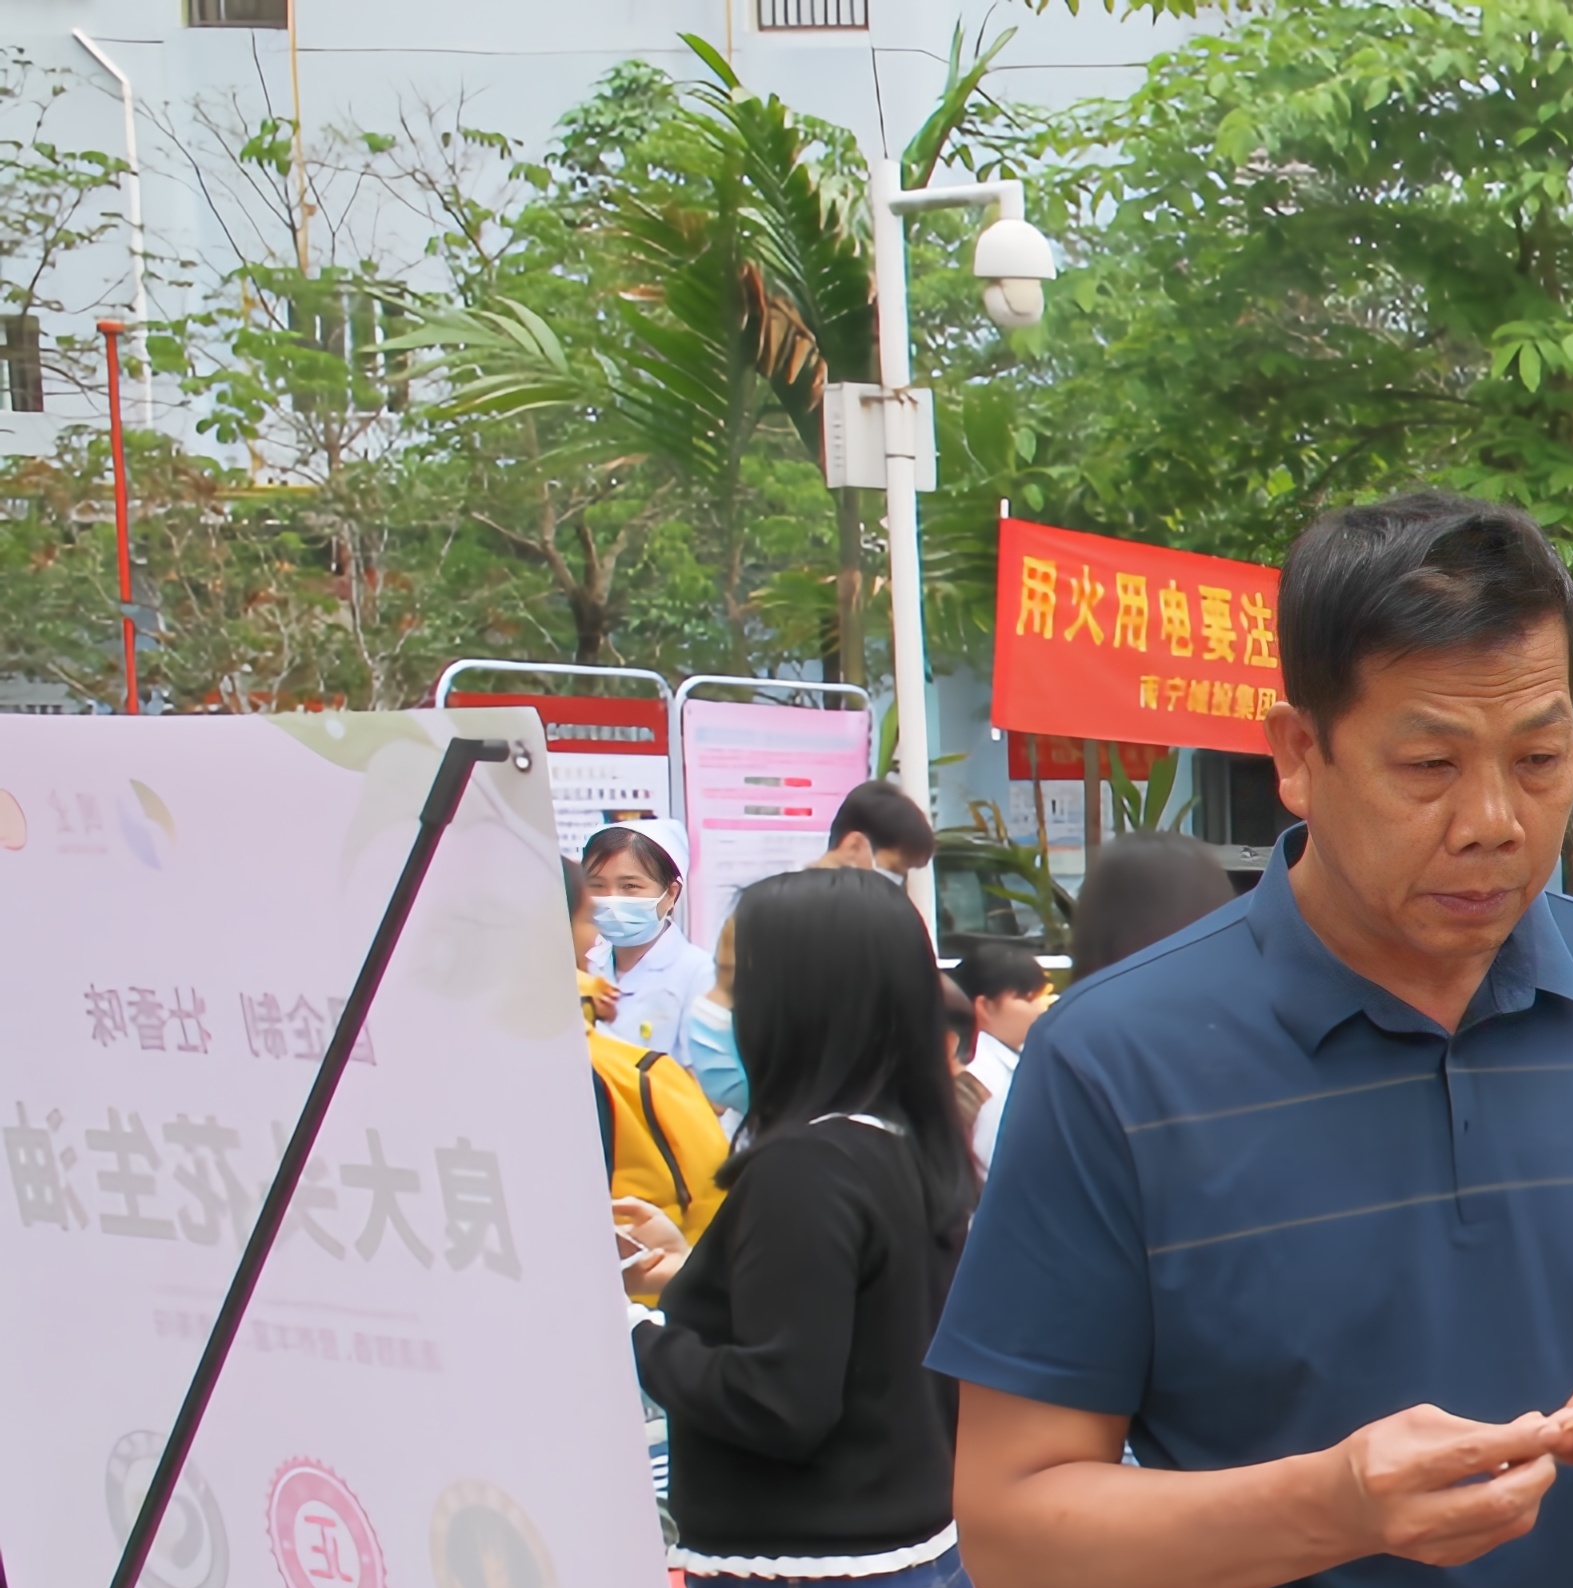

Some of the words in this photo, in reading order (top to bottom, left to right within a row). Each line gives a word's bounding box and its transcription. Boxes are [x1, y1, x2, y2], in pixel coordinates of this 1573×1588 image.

[1016, 556, 1277, 668] 用火用电要注
